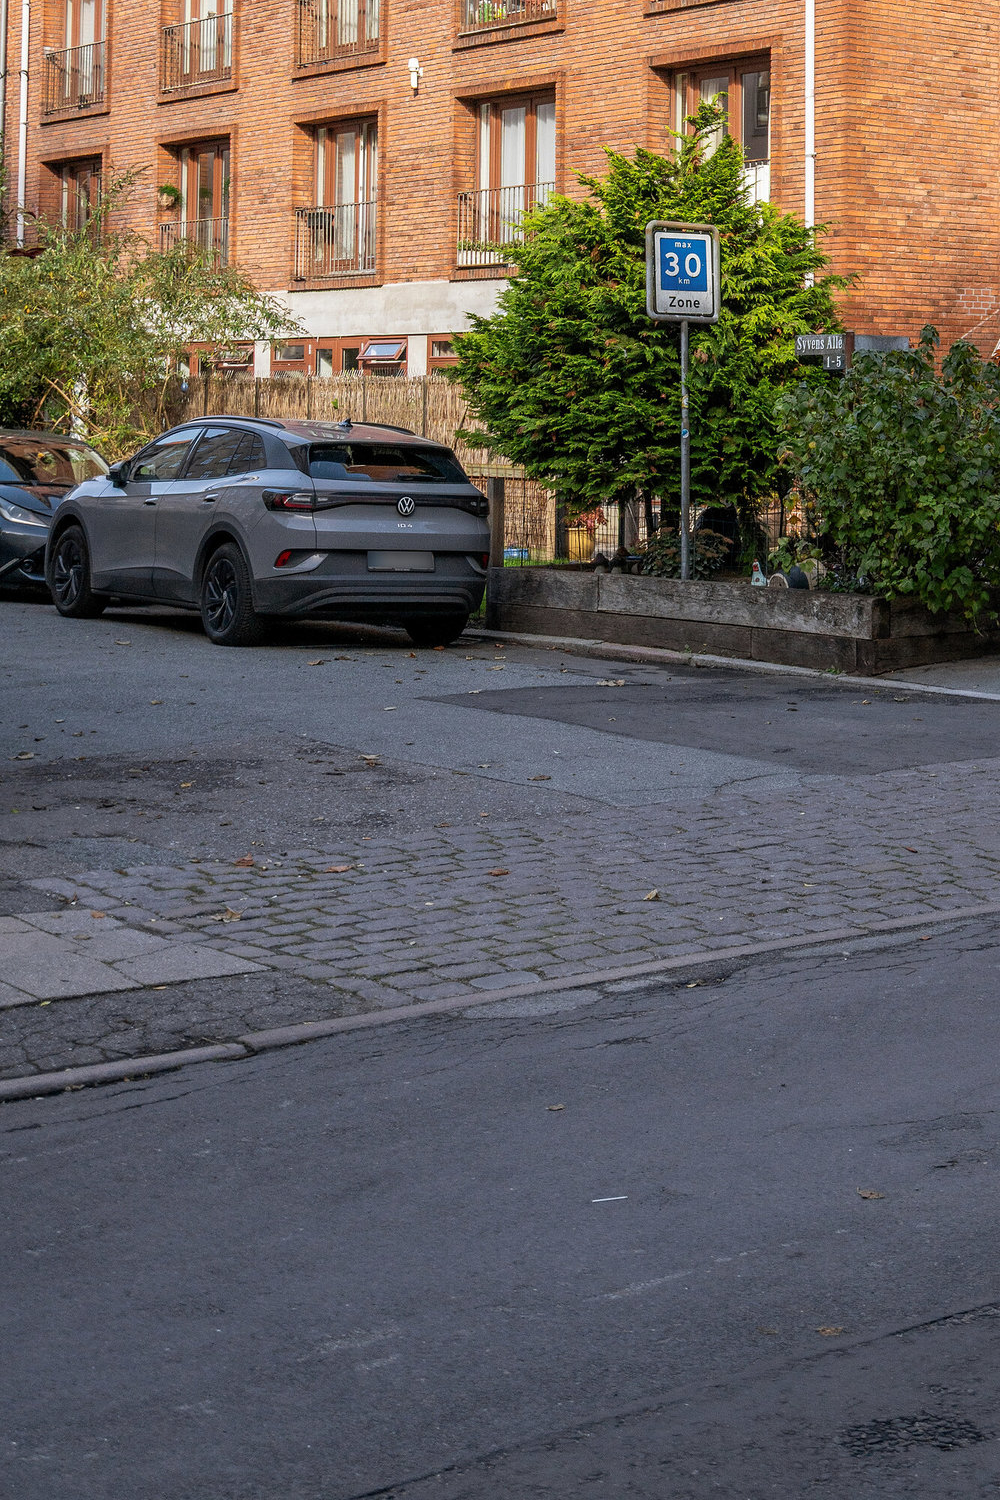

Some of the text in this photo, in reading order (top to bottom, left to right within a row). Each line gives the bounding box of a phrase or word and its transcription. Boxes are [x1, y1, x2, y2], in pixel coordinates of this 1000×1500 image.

[665, 252, 701, 278] 30
[678, 277, 691, 285] km
[669, 296, 700, 308] Zone
[797, 335, 843, 353] Syvens Allé
